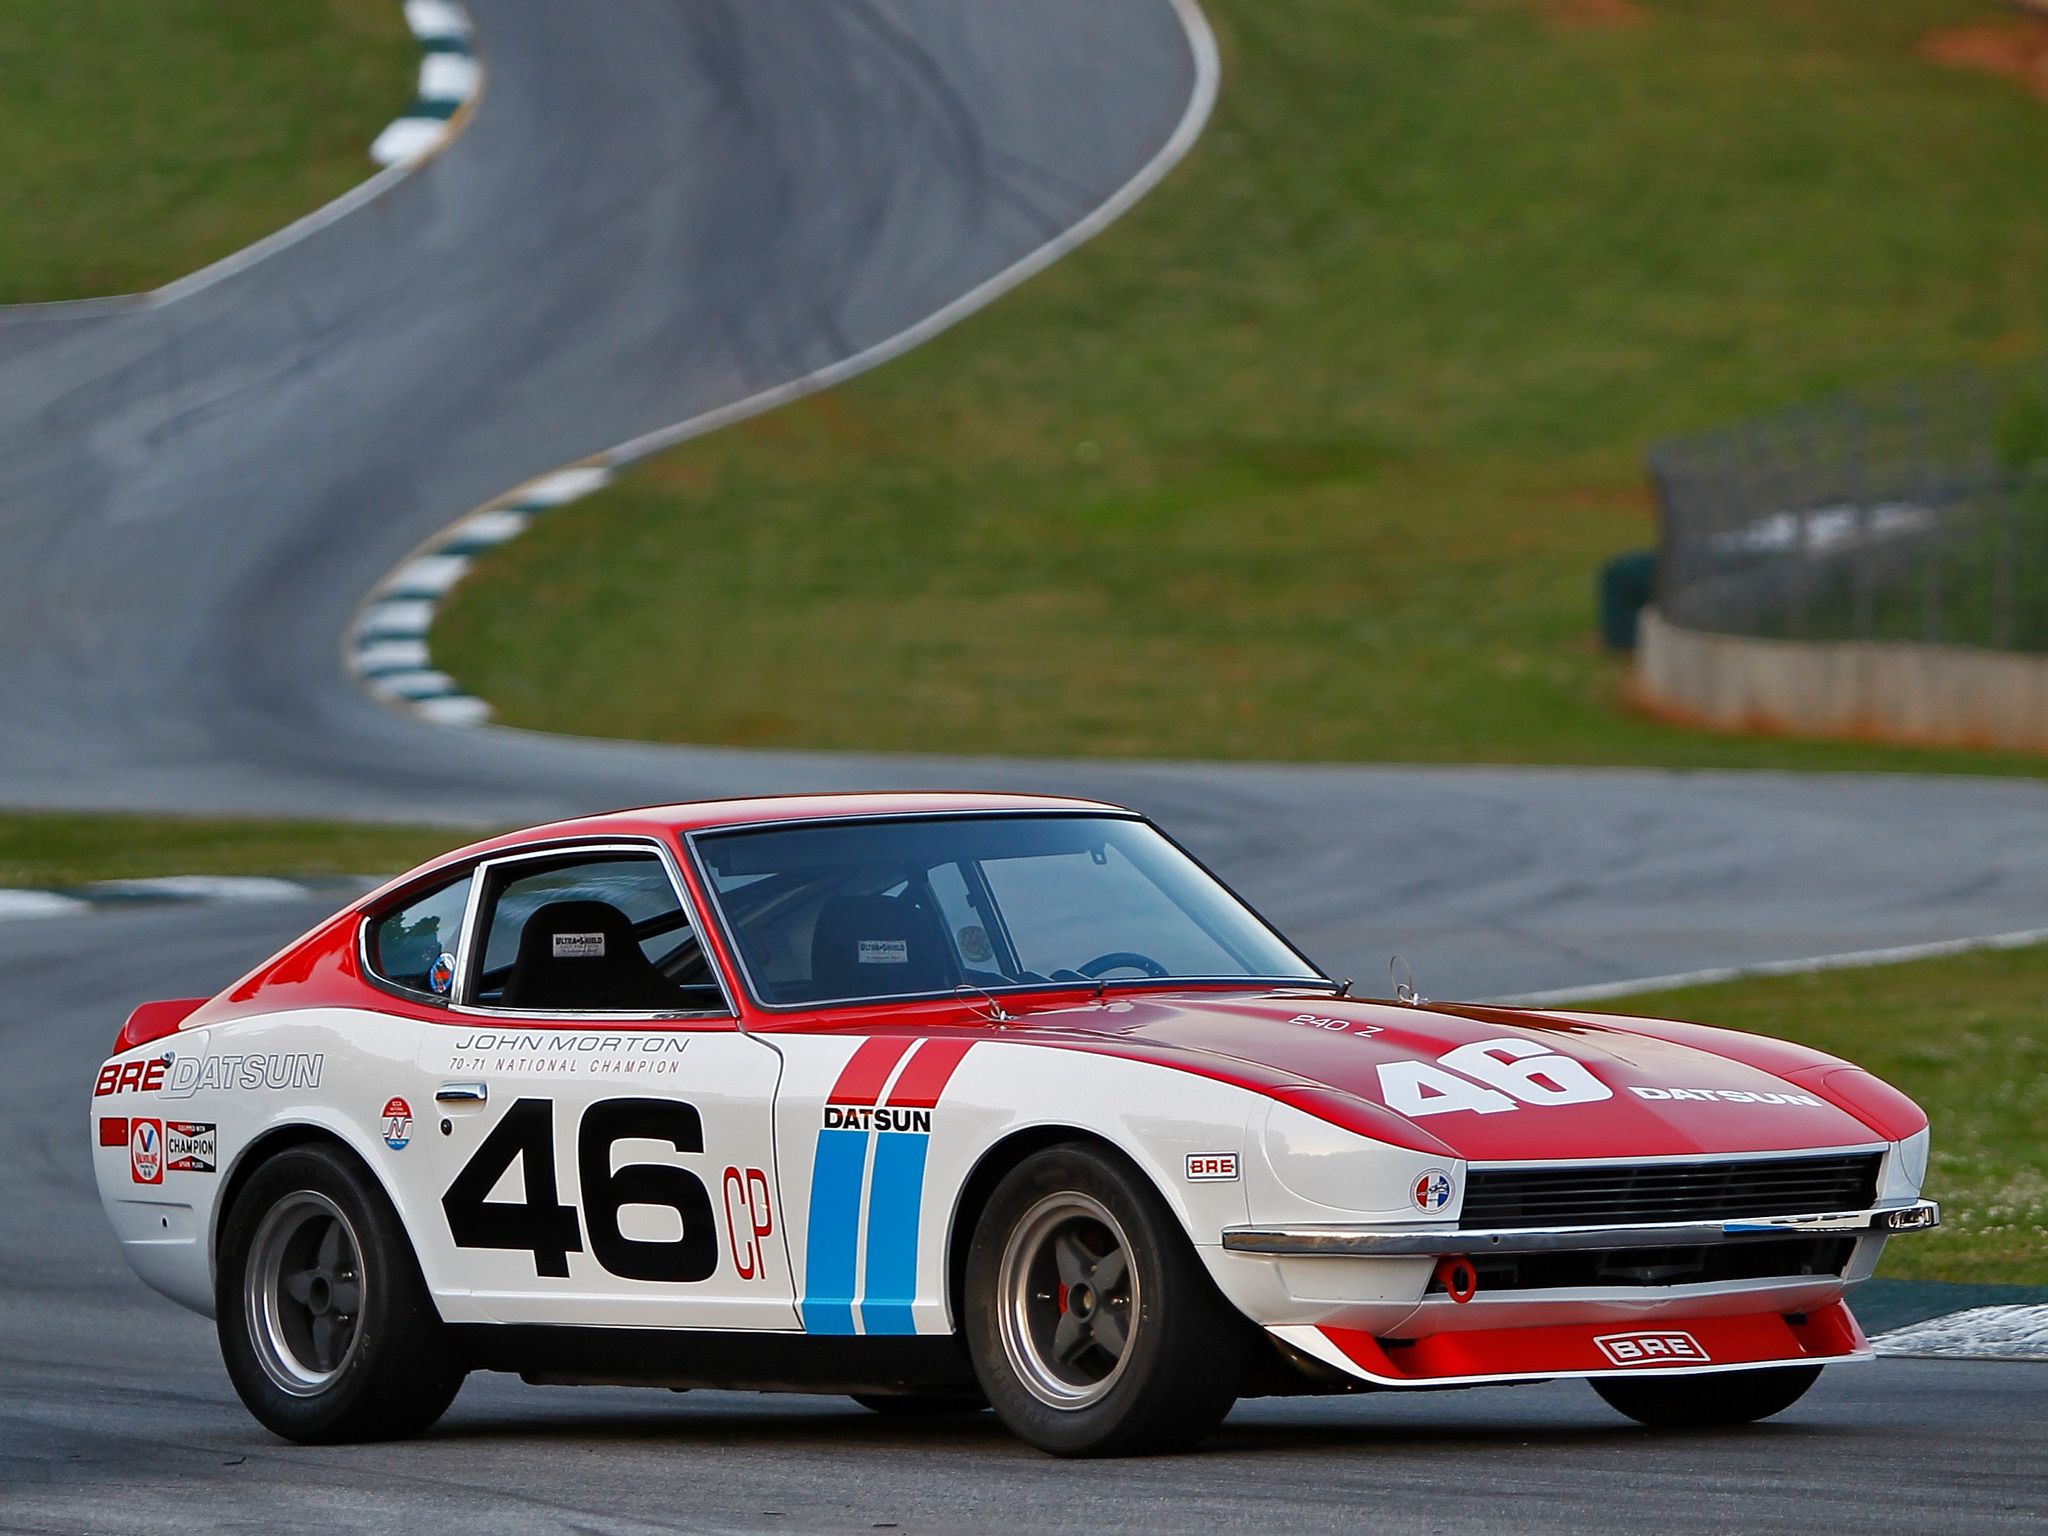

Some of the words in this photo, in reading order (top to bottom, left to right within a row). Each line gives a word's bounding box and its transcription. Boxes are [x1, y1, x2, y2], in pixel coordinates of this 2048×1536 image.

[1288, 1014, 1350, 1031] 240
[1354, 1025, 1384, 1038] Z
[455, 1034, 544, 1051] JOHN
[547, 1035, 691, 1053] MORTON
[94, 1058, 166, 1097] BRE
[170, 1053, 324, 1090] DATSUN
[449, 1057, 486, 1071] 70-71
[494, 1058, 577, 1073] NATIONAL
[589, 1059, 680, 1074] CHAMPION
[1375, 1037, 1614, 1117] 46
[1627, 1086, 1823, 1107] DATSUN
[823, 1107, 931, 1132] DATSUN
[168, 1138, 214, 1155] CHAMPION
[1190, 1159, 1233, 1173] BRE
[441, 1097, 719, 1282] 46
[723, 1165, 773, 1280] CP
[1609, 1338, 1695, 1359] BRE
